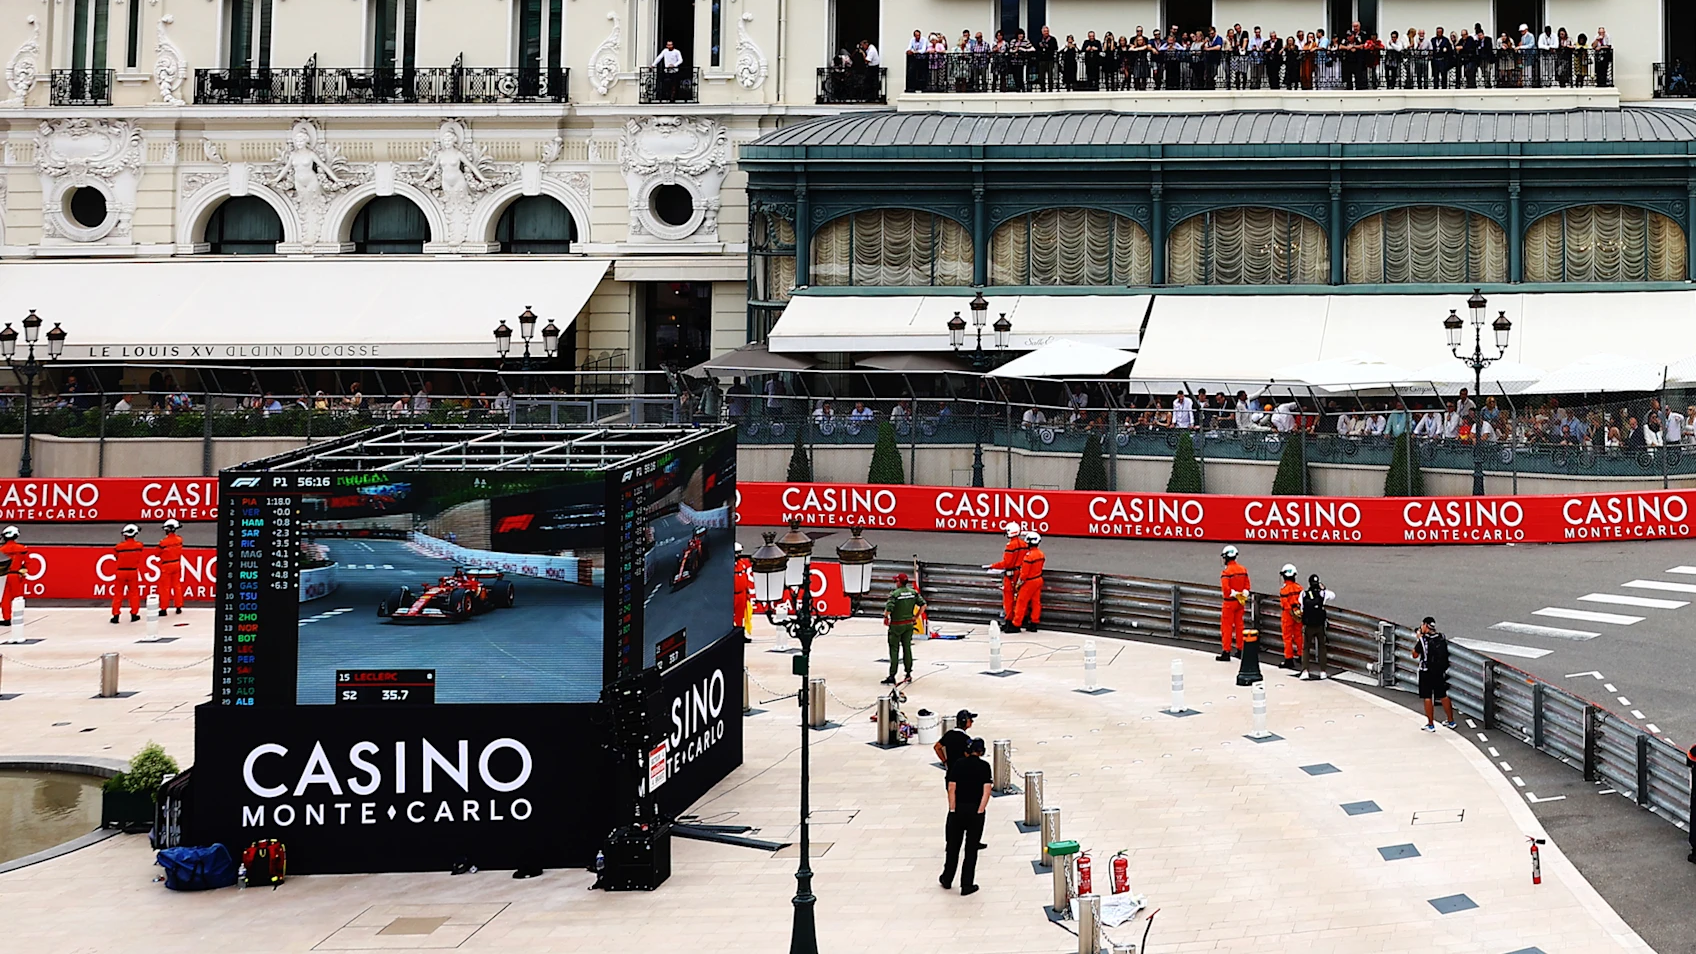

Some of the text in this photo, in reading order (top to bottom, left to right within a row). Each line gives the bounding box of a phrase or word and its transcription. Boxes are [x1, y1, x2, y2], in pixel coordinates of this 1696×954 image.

[89, 347, 111, 357] LE
[123, 347, 179, 357] LOUIS
[191, 347, 215, 357] XV
[273, 477, 288, 487] P1
[297, 477, 330, 487] 56:16
[0, 483, 99, 506] ASINO
[142, 482, 219, 506] CASI
[782, 487, 896, 512] CASINO
[935, 491, 1049, 518] CASINO
[1089, 496, 1203, 524] CASINO
[1563, 494, 1688, 525] CASINO
[46, 509, 98, 518] CARLO
[141, 508, 198, 518] MONTE
[782, 513, 896, 527] MONTE CARLO
[1244, 501, 1361, 528] CASINO
[1403, 501, 1524, 528] CASINO
[935, 518, 991, 530] MONTE
[1089, 522, 1204, 538] MONTE CARLO
[1564, 523, 1689, 539] MONTE CARLO
[1245, 528, 1362, 541] MONTE CARLO
[1404, 529, 1525, 540] MONTE CARLO
[241, 550, 262, 558] MAG
[240, 571, 258, 579] RUS
[339, 672, 398, 681] 15 LECLERC
[342, 690, 409, 700] S2 35.7
[688, 720, 724, 762] CARLO
[243, 738, 533, 798] CASINO
[242, 798, 532, 827] MONTE CARLO
